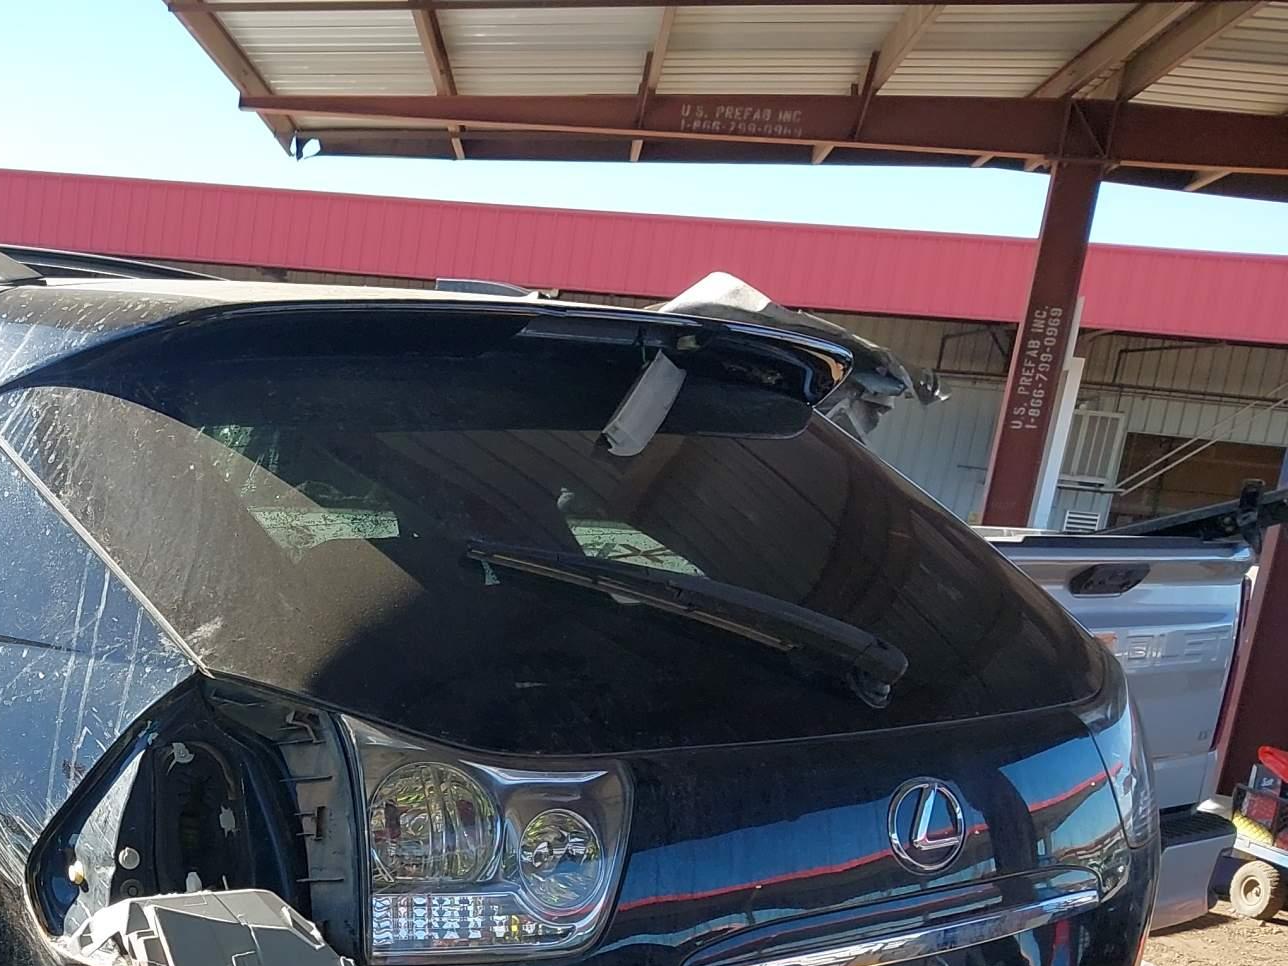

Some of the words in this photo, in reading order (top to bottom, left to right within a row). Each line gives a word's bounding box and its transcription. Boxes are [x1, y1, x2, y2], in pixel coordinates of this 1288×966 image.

[715, 106, 772, 121] PREFAB
[1016, 340, 1042, 395] PREFAB
[1024, 307, 1063, 429] 1-866-799-0969
